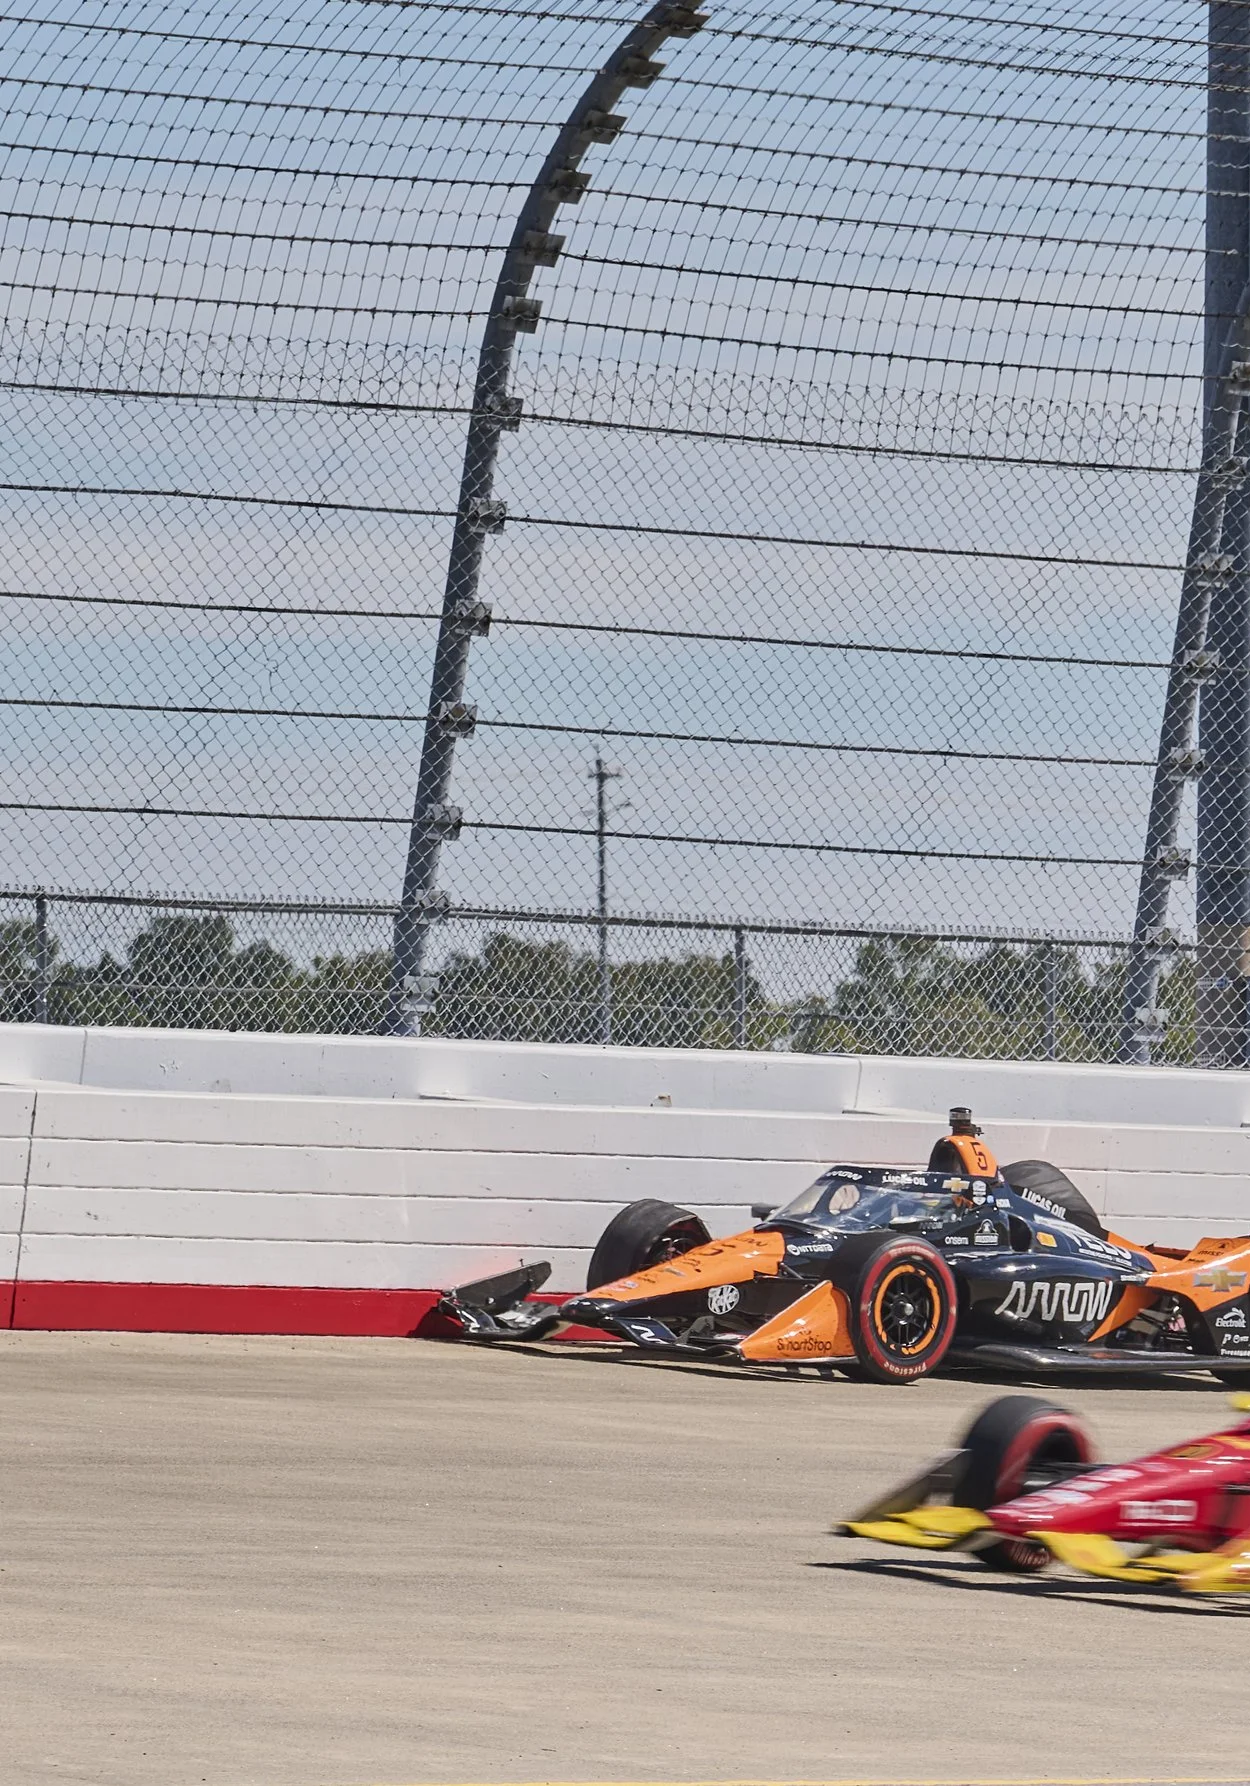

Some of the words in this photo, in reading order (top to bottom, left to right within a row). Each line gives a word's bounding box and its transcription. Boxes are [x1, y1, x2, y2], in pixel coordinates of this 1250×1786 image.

[970, 1141, 988, 1170] 5
[913, 1177, 928, 1186] OIL
[1022, 1188, 1053, 1212] LUCAS
[1051, 1203, 1067, 1221] OIL
